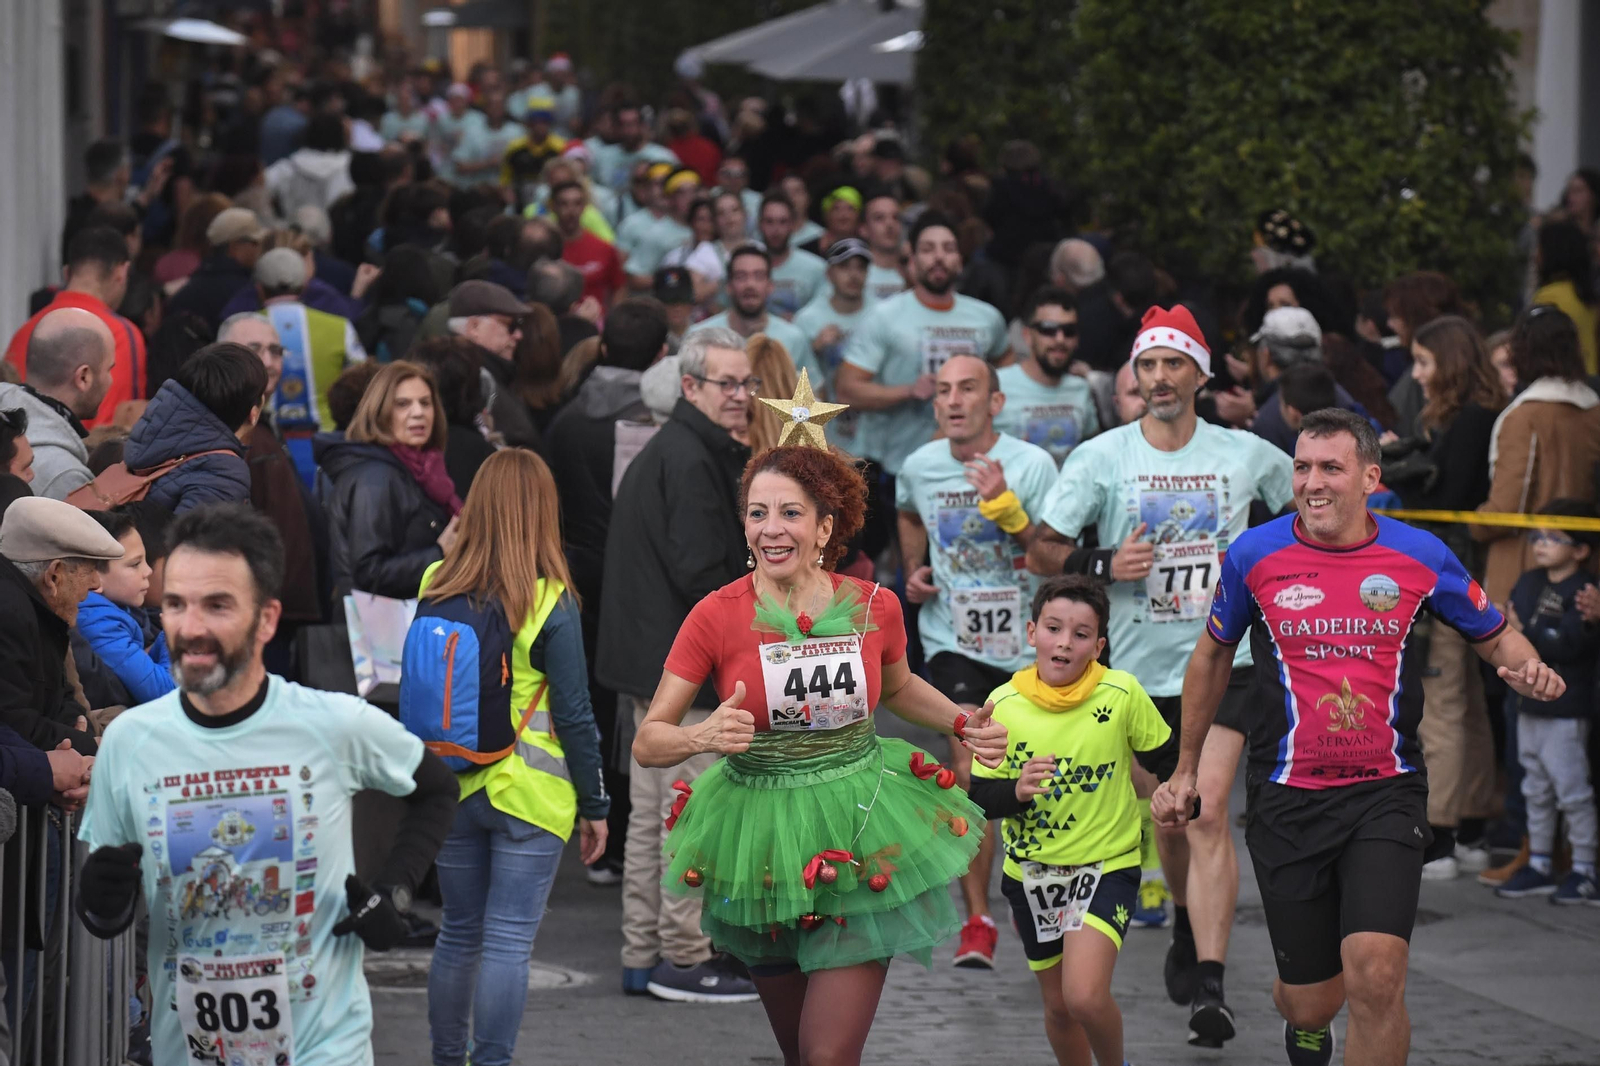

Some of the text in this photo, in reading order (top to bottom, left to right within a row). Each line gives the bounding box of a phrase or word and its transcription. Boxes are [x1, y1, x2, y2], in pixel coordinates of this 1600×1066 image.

[1159, 563, 1211, 592] 777
[967, 608, 1012, 633] 312
[1279, 618, 1400, 636] GADEIRAS
[1304, 645, 1377, 660] SPORT
[784, 662, 857, 702] 444
[1317, 733, 1374, 747] SERVÁN
[164, 765, 290, 787] III SAN SILVESTRE
[182, 779, 278, 797] GADITANA
[195, 989, 280, 1033] 803
